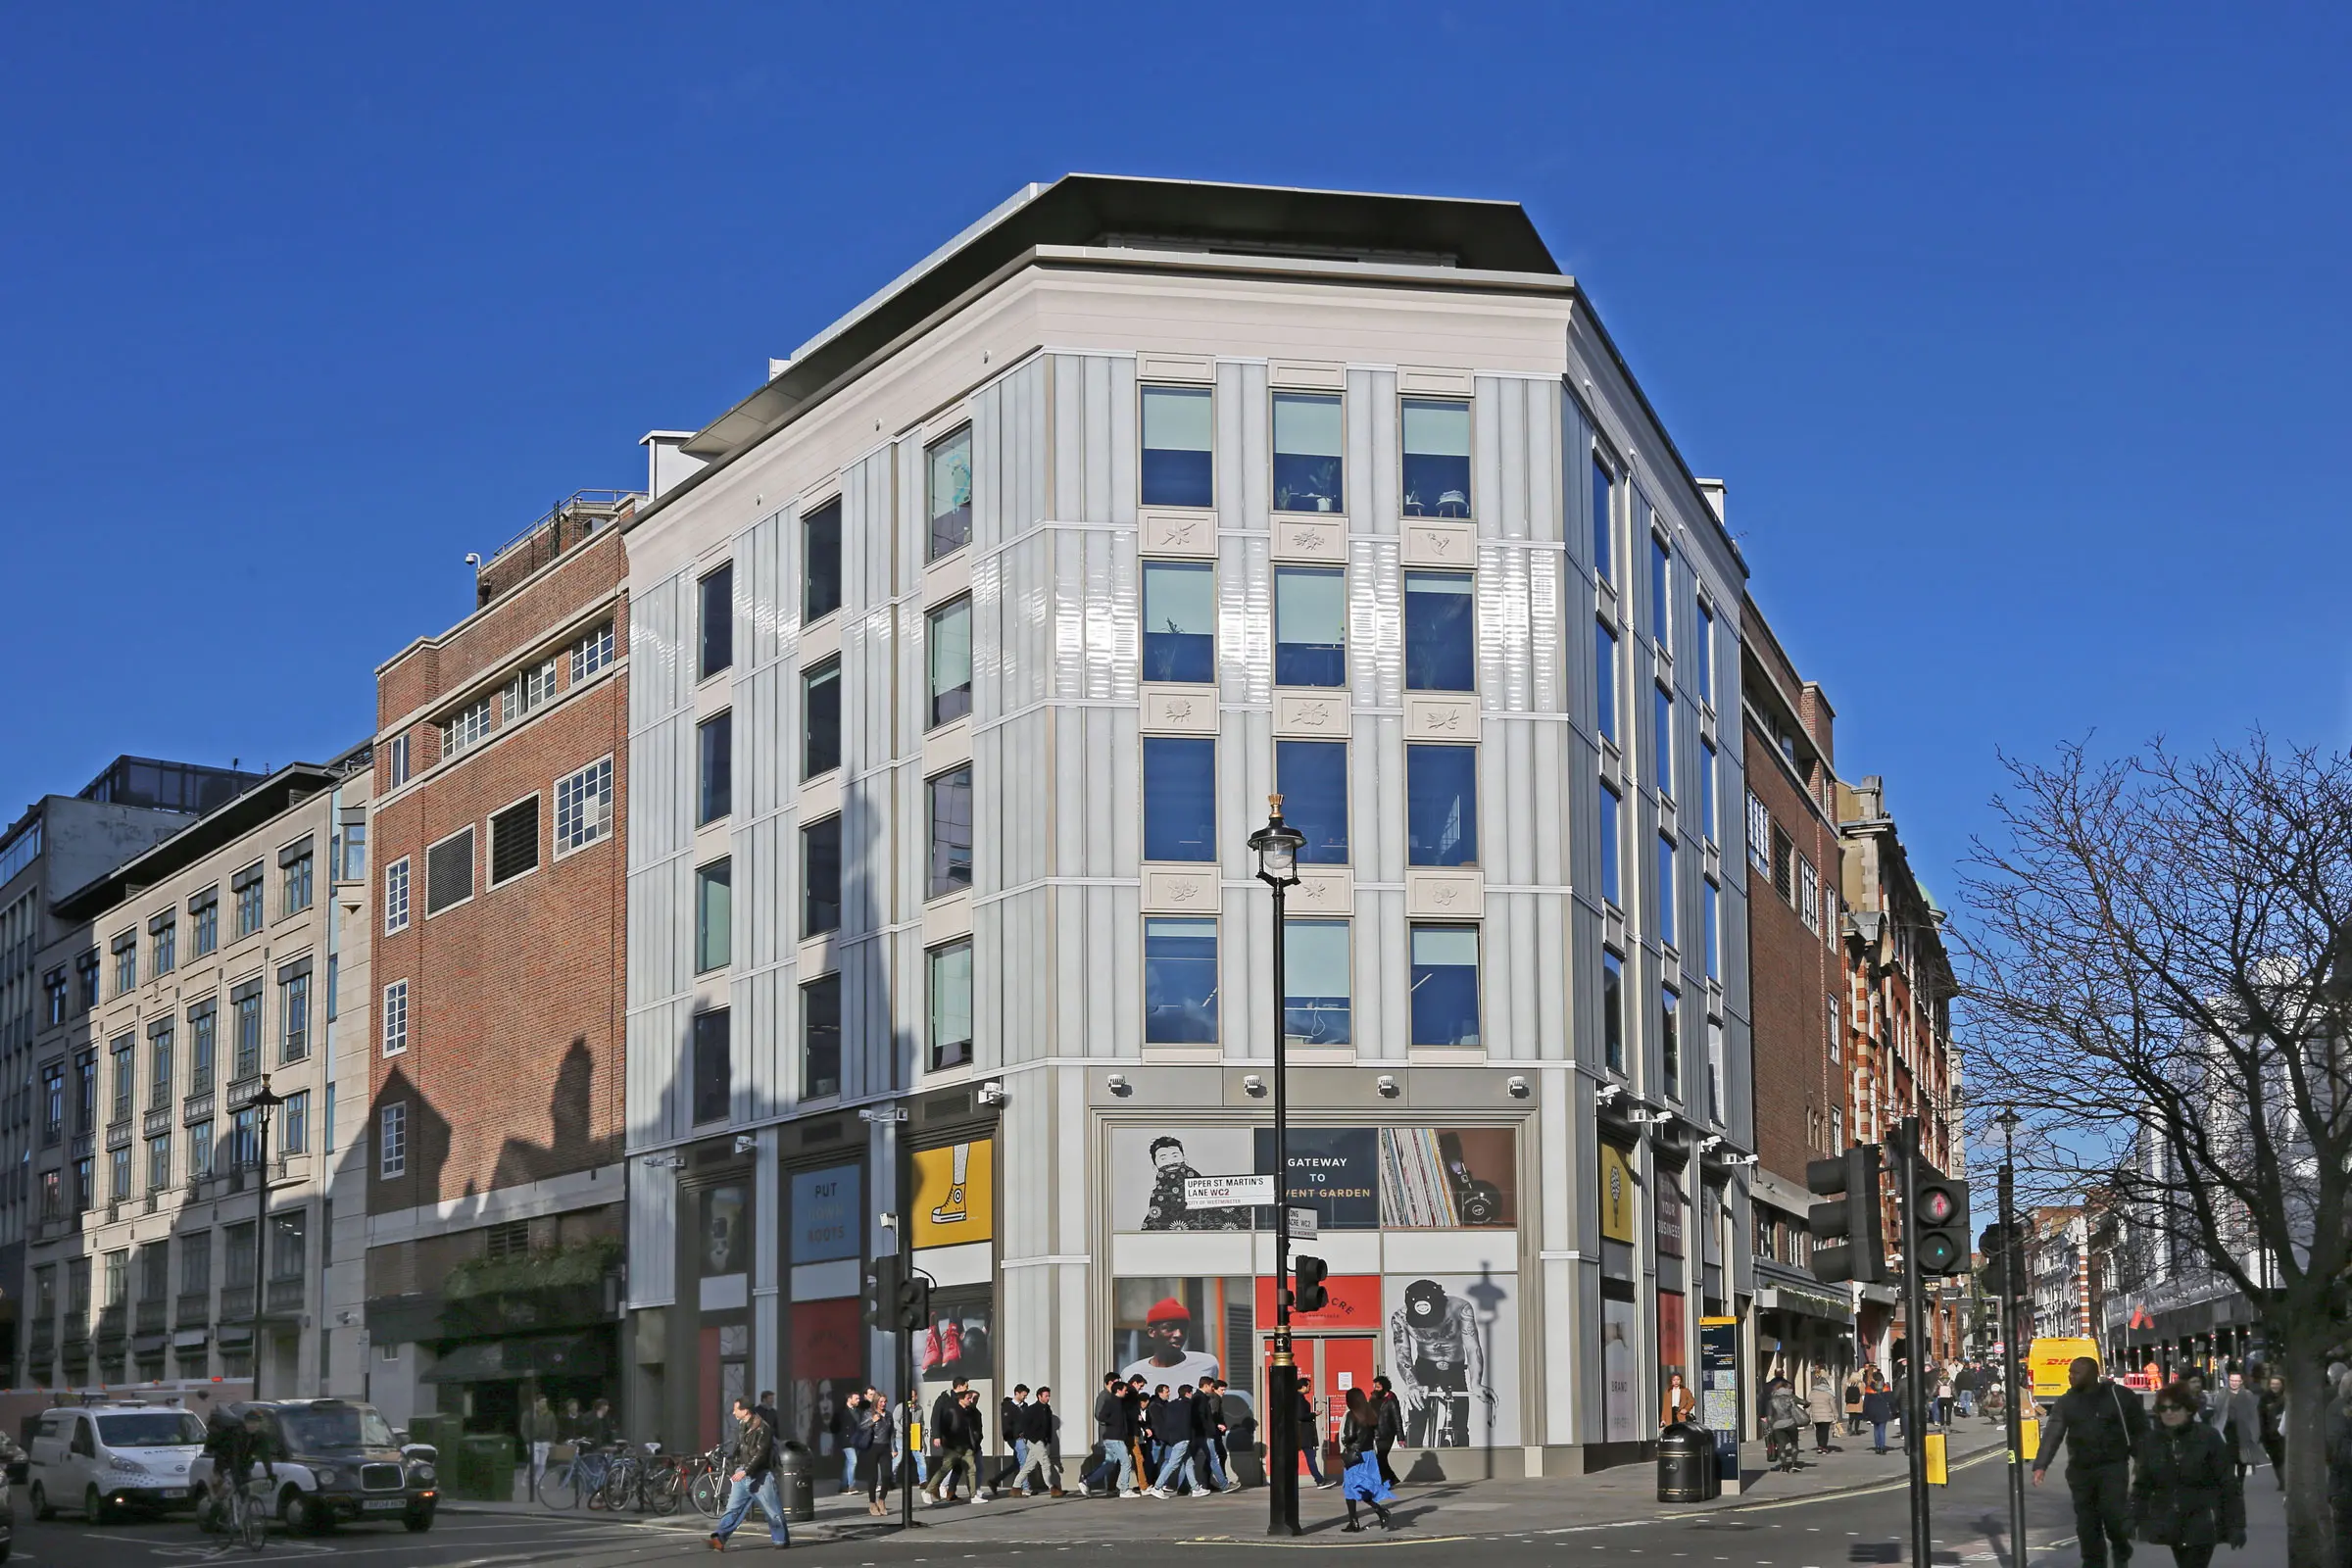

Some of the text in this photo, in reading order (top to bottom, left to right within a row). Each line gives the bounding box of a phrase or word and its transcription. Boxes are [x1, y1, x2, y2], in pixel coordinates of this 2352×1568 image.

[1287, 1157, 1348, 1167] GATEWAY
[1188, 1177, 1264, 1189] UPPER ST MARTIN'S
[1309, 1173, 1326, 1182] TO
[814, 1182, 837, 1198] PUT
[1188, 1188, 1230, 1198] LANE WC2
[1319, 1189, 1371, 1198] GARDEN
[1657, 1219, 1681, 1239] BUSINESS
[1331, 1297, 1354, 1315] CRE
